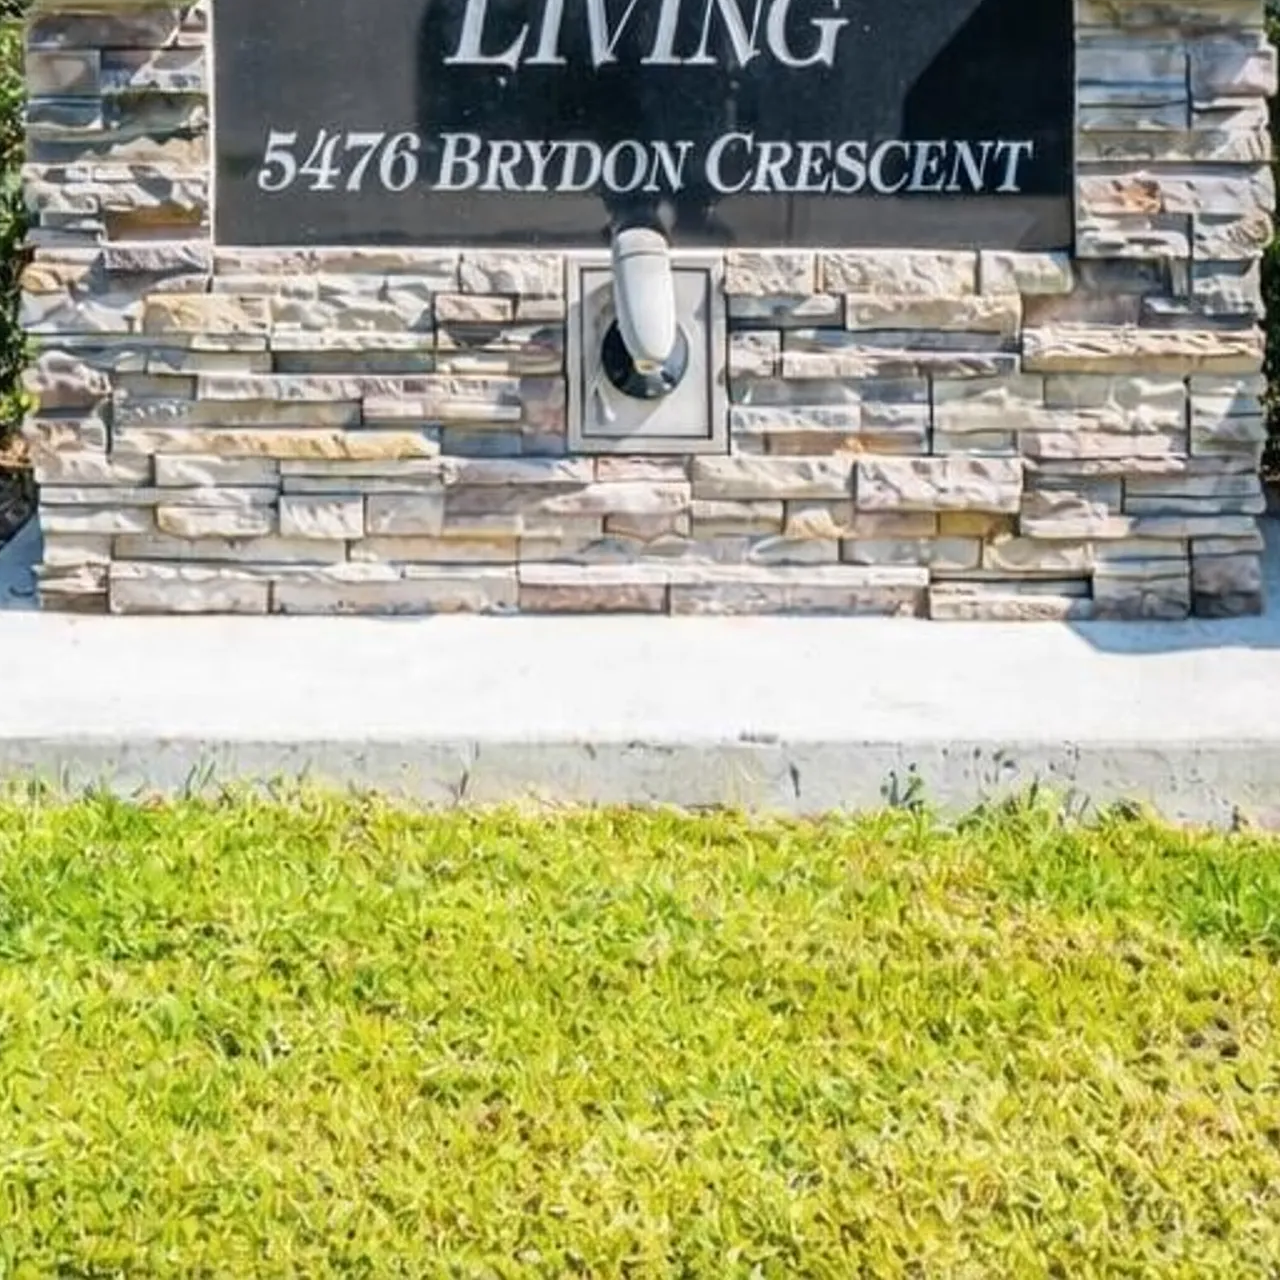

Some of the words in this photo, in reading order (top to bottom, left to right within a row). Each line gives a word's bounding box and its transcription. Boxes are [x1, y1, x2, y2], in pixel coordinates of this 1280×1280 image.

[257, 128, 421, 193] 5476
[431, 132, 694, 193] BRYDON
[705, 131, 1034, 194] CRESCENT
